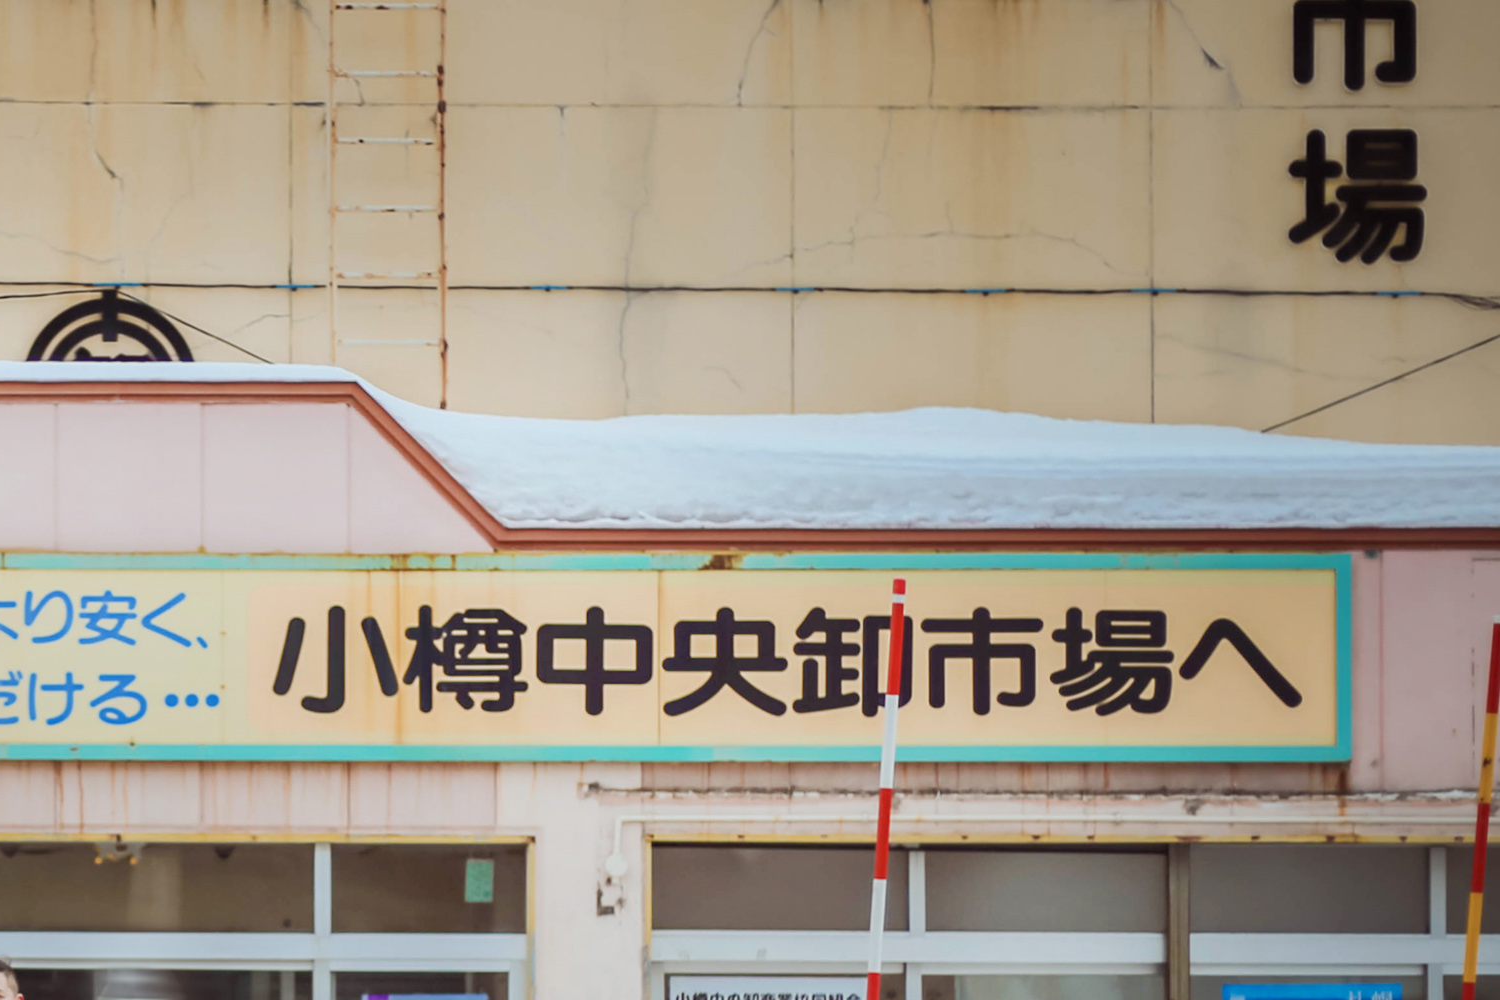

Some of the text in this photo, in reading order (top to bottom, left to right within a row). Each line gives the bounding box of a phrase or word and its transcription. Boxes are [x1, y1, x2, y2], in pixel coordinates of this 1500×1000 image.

[1287, 0, 1428, 265] 市場
[272, 605, 1303, 717] 小樽中央卸市場へ
